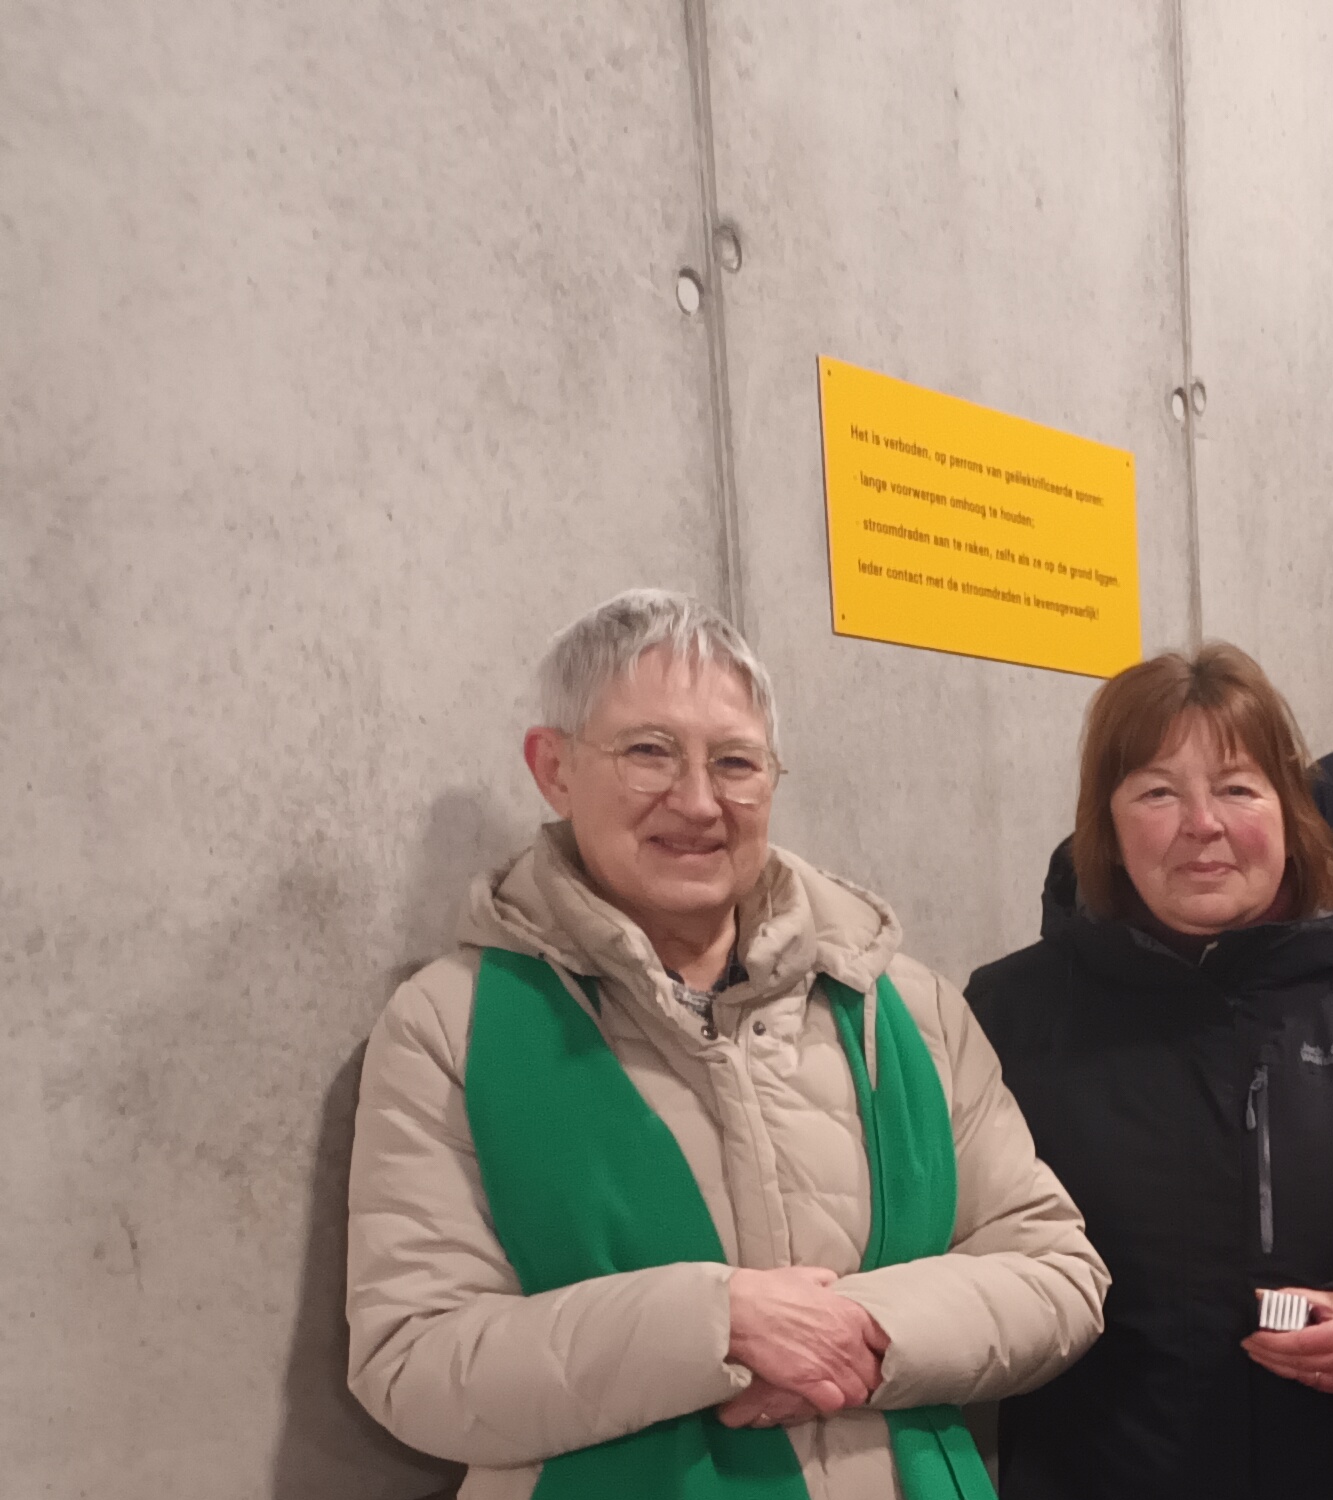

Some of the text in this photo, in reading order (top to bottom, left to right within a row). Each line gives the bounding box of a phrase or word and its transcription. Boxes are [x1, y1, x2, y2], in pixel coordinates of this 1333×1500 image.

[850, 423, 868, 443] Het
[871, 430, 880, 446] is
[934, 451, 946, 466] op
[949, 454, 982, 474] perrons
[986, 466, 1002, 479] van
[860, 470, 887, 493] lange
[890, 482, 947, 505] voorwerpen
[989, 506, 998, 518] te
[863, 518, 930, 544] stroomdraden
[933, 535, 950, 548] aan
[953, 538, 962, 551] te
[996, 548, 1015, 563] zelfs
[1044, 561, 1055, 574] op
[1057, 562, 1067, 575] de
[858, 558, 882, 577] Ieder
[886, 567, 923, 586] contact
[926, 575, 944, 589] met
[947, 576, 958, 592] de
[961, 582, 1021, 605] stroomdraden
[1024, 592, 1031, 607] is
